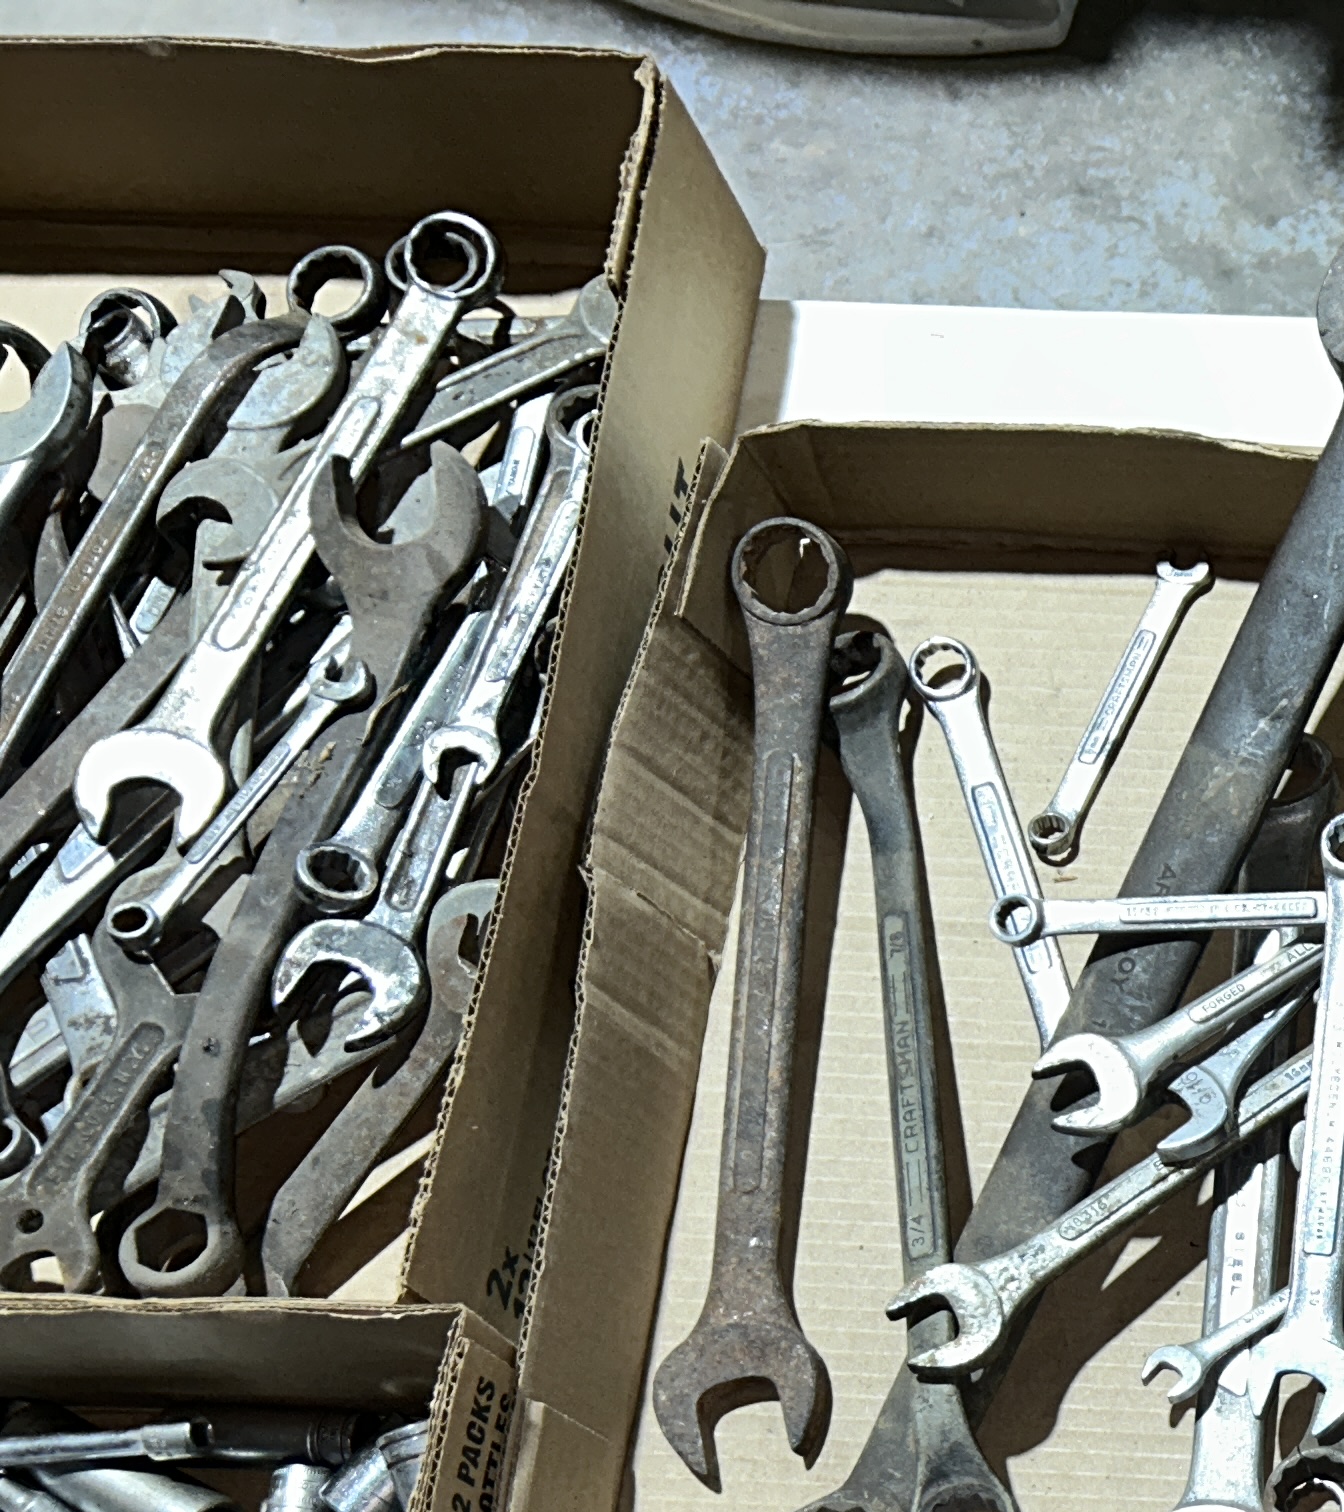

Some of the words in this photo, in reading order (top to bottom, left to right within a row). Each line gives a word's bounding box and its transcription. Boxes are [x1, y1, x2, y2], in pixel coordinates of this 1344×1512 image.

[1201, 983, 1247, 1014] FORGED
[896, 1020, 921, 1154] CRAFTSMAN
[910, 1213, 925, 1247] 3/4
[456, 1375, 496, 1488] PACKS
